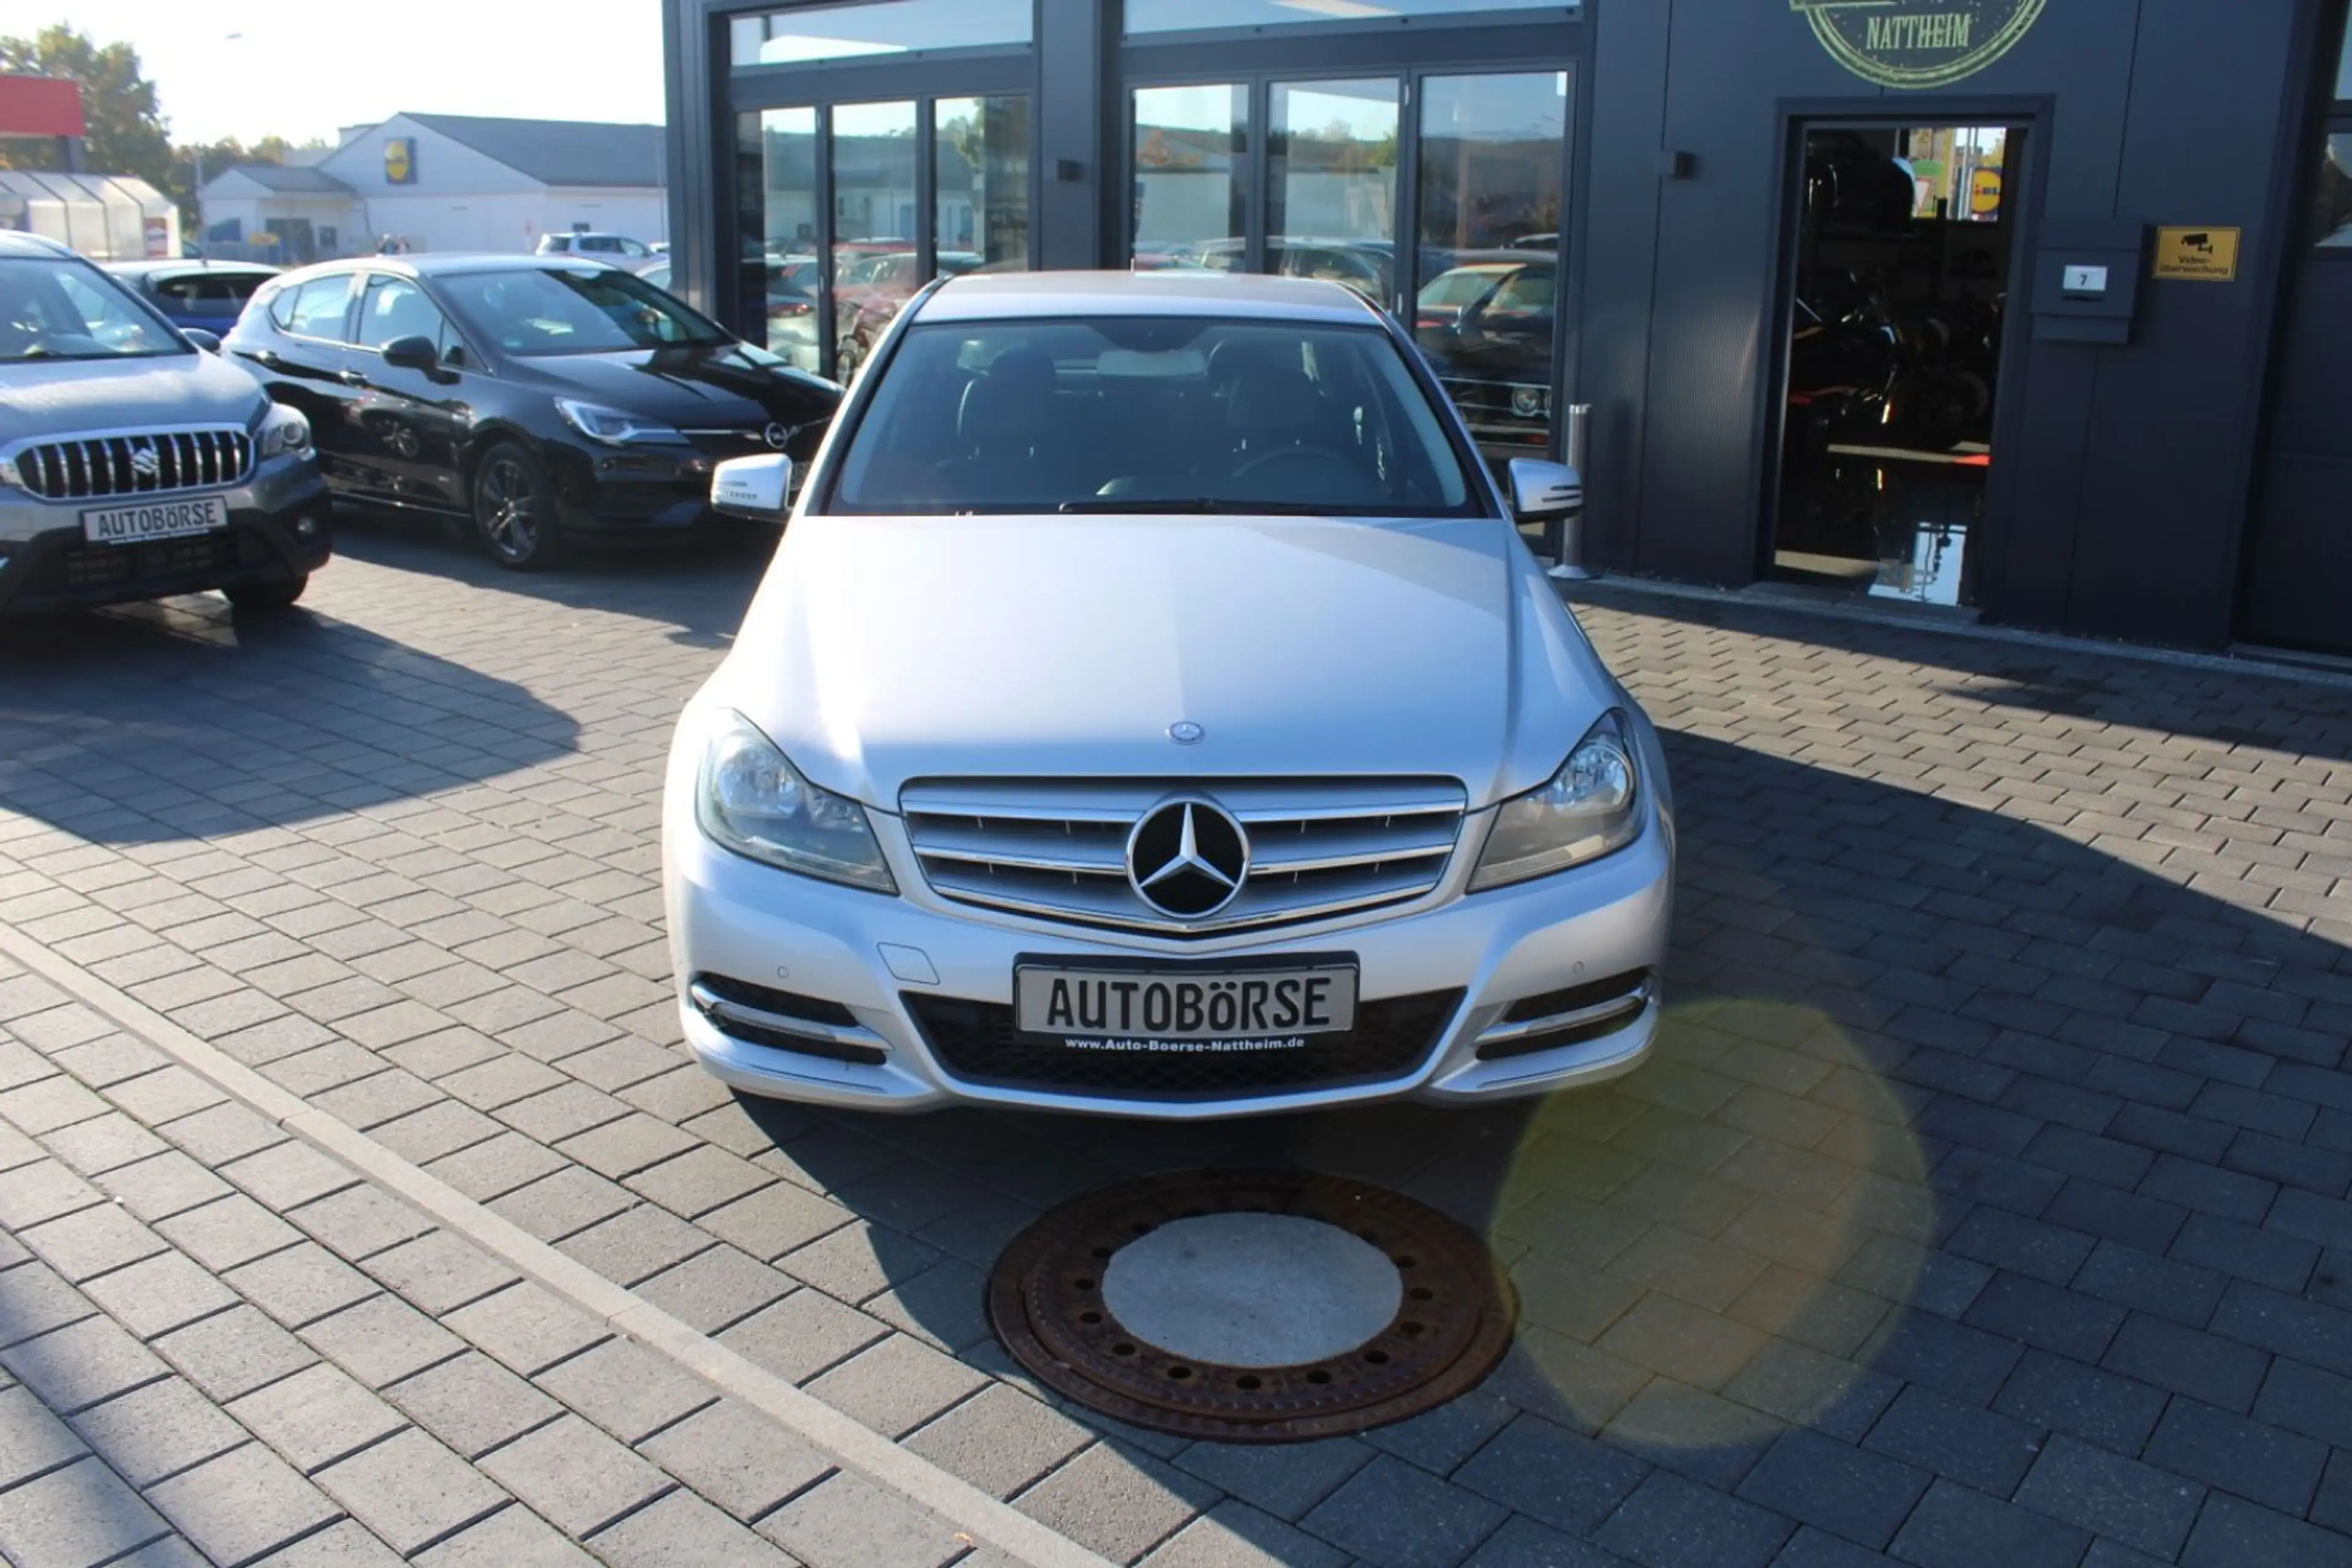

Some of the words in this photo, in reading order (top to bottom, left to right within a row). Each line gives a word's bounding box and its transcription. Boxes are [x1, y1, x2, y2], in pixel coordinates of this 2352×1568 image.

[1866, 13, 1971, 49] NATTHEIM
[2080, 274, 2087, 286] 7
[1047, 978, 1331, 1031] AUTOBÖRSE
[1065, 1037, 1305, 1052] www.Auto-Boerse-Nattheim.de
